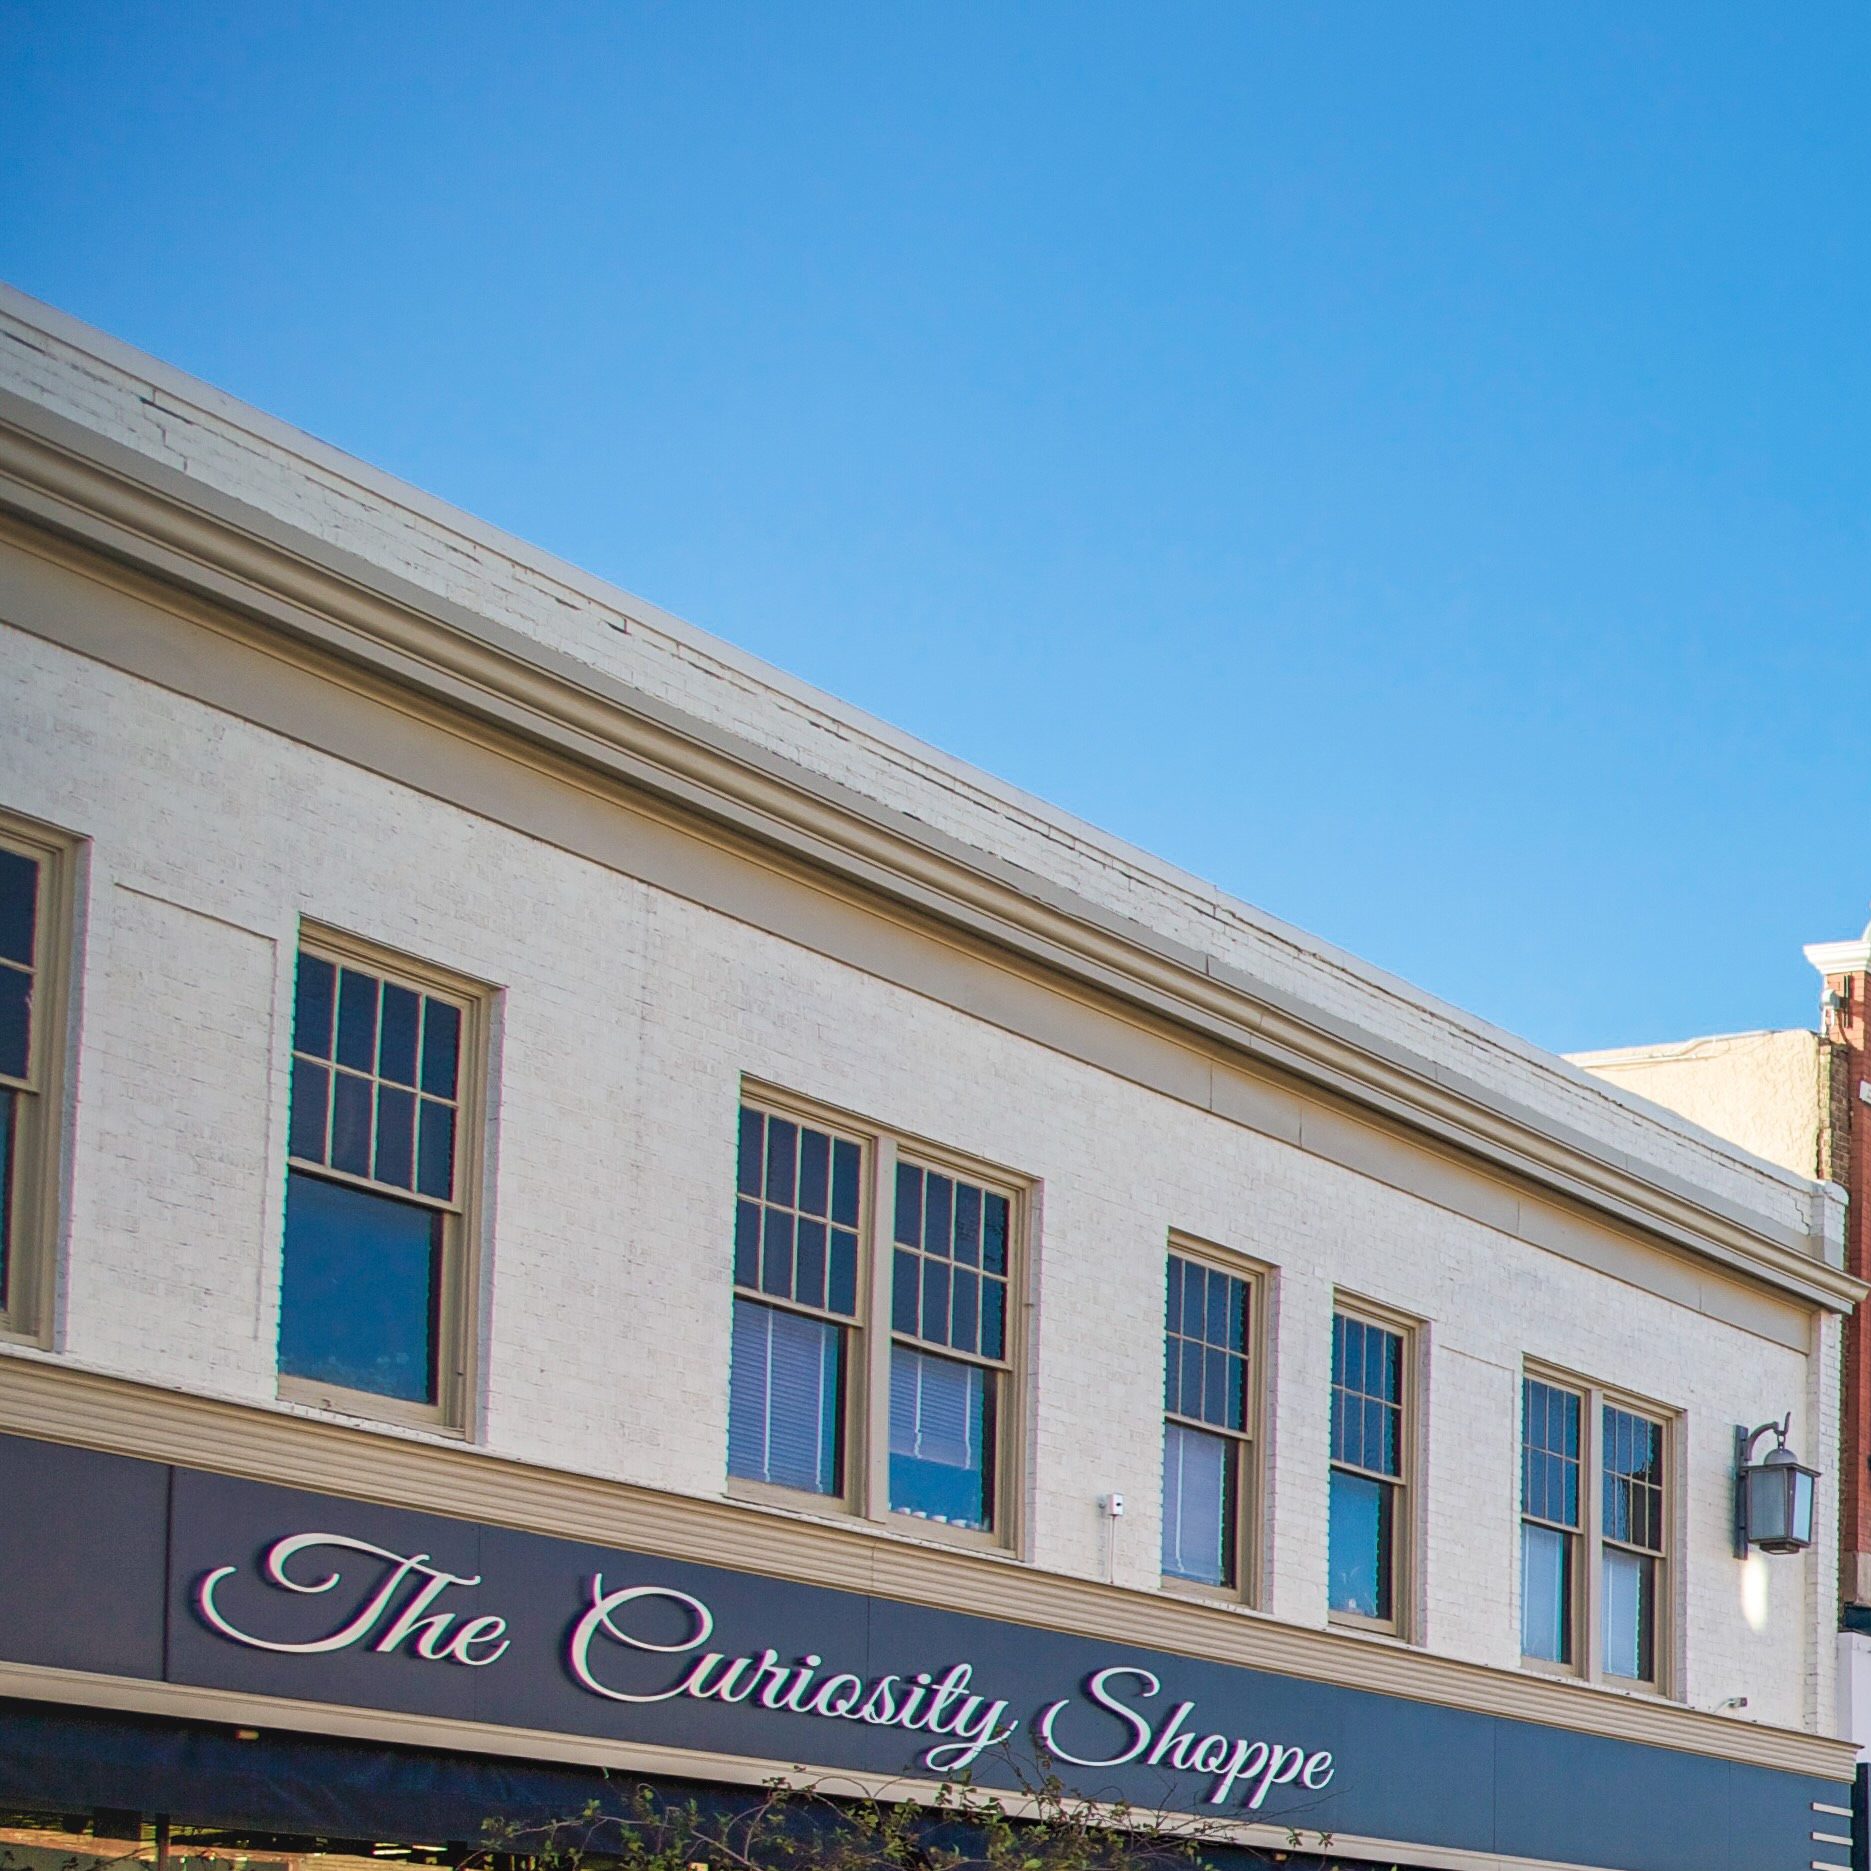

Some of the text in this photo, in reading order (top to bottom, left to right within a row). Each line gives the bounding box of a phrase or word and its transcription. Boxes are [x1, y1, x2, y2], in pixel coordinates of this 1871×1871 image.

[200, 1533, 1335, 1808] The Curiosity Shoppe
